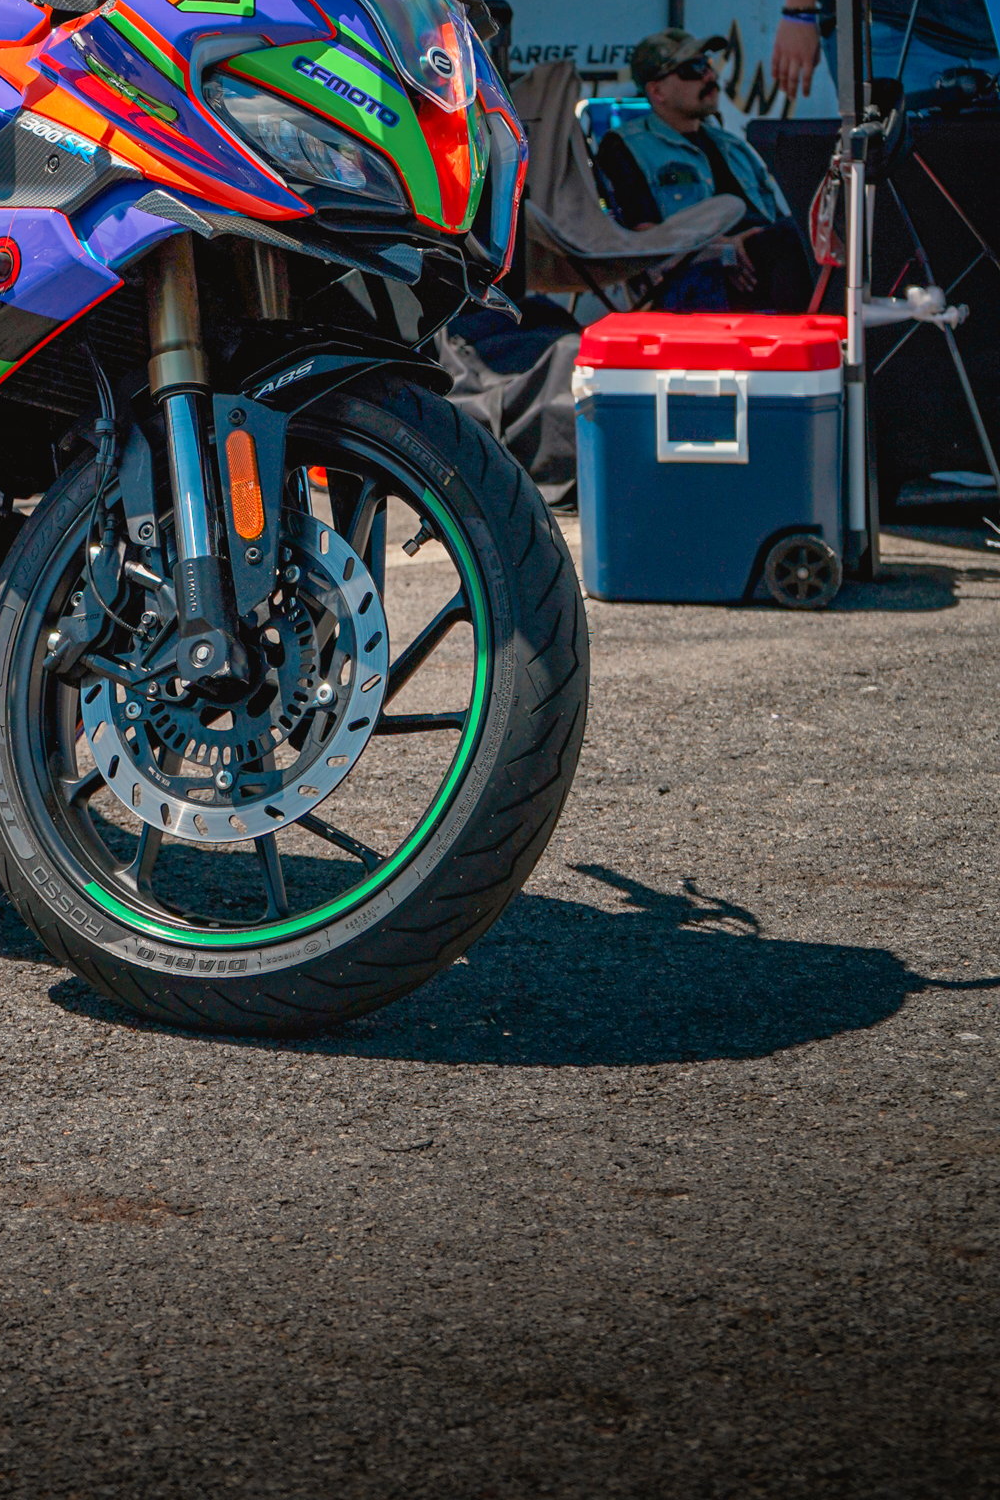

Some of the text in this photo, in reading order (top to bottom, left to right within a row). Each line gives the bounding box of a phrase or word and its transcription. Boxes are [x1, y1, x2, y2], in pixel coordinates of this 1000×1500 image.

[292, 54, 401, 129] CFMOTO
[253, 359, 315, 400] ABS
[31, 864, 105, 938] ROSSO
[136, 945, 248, 975] DIABLO
